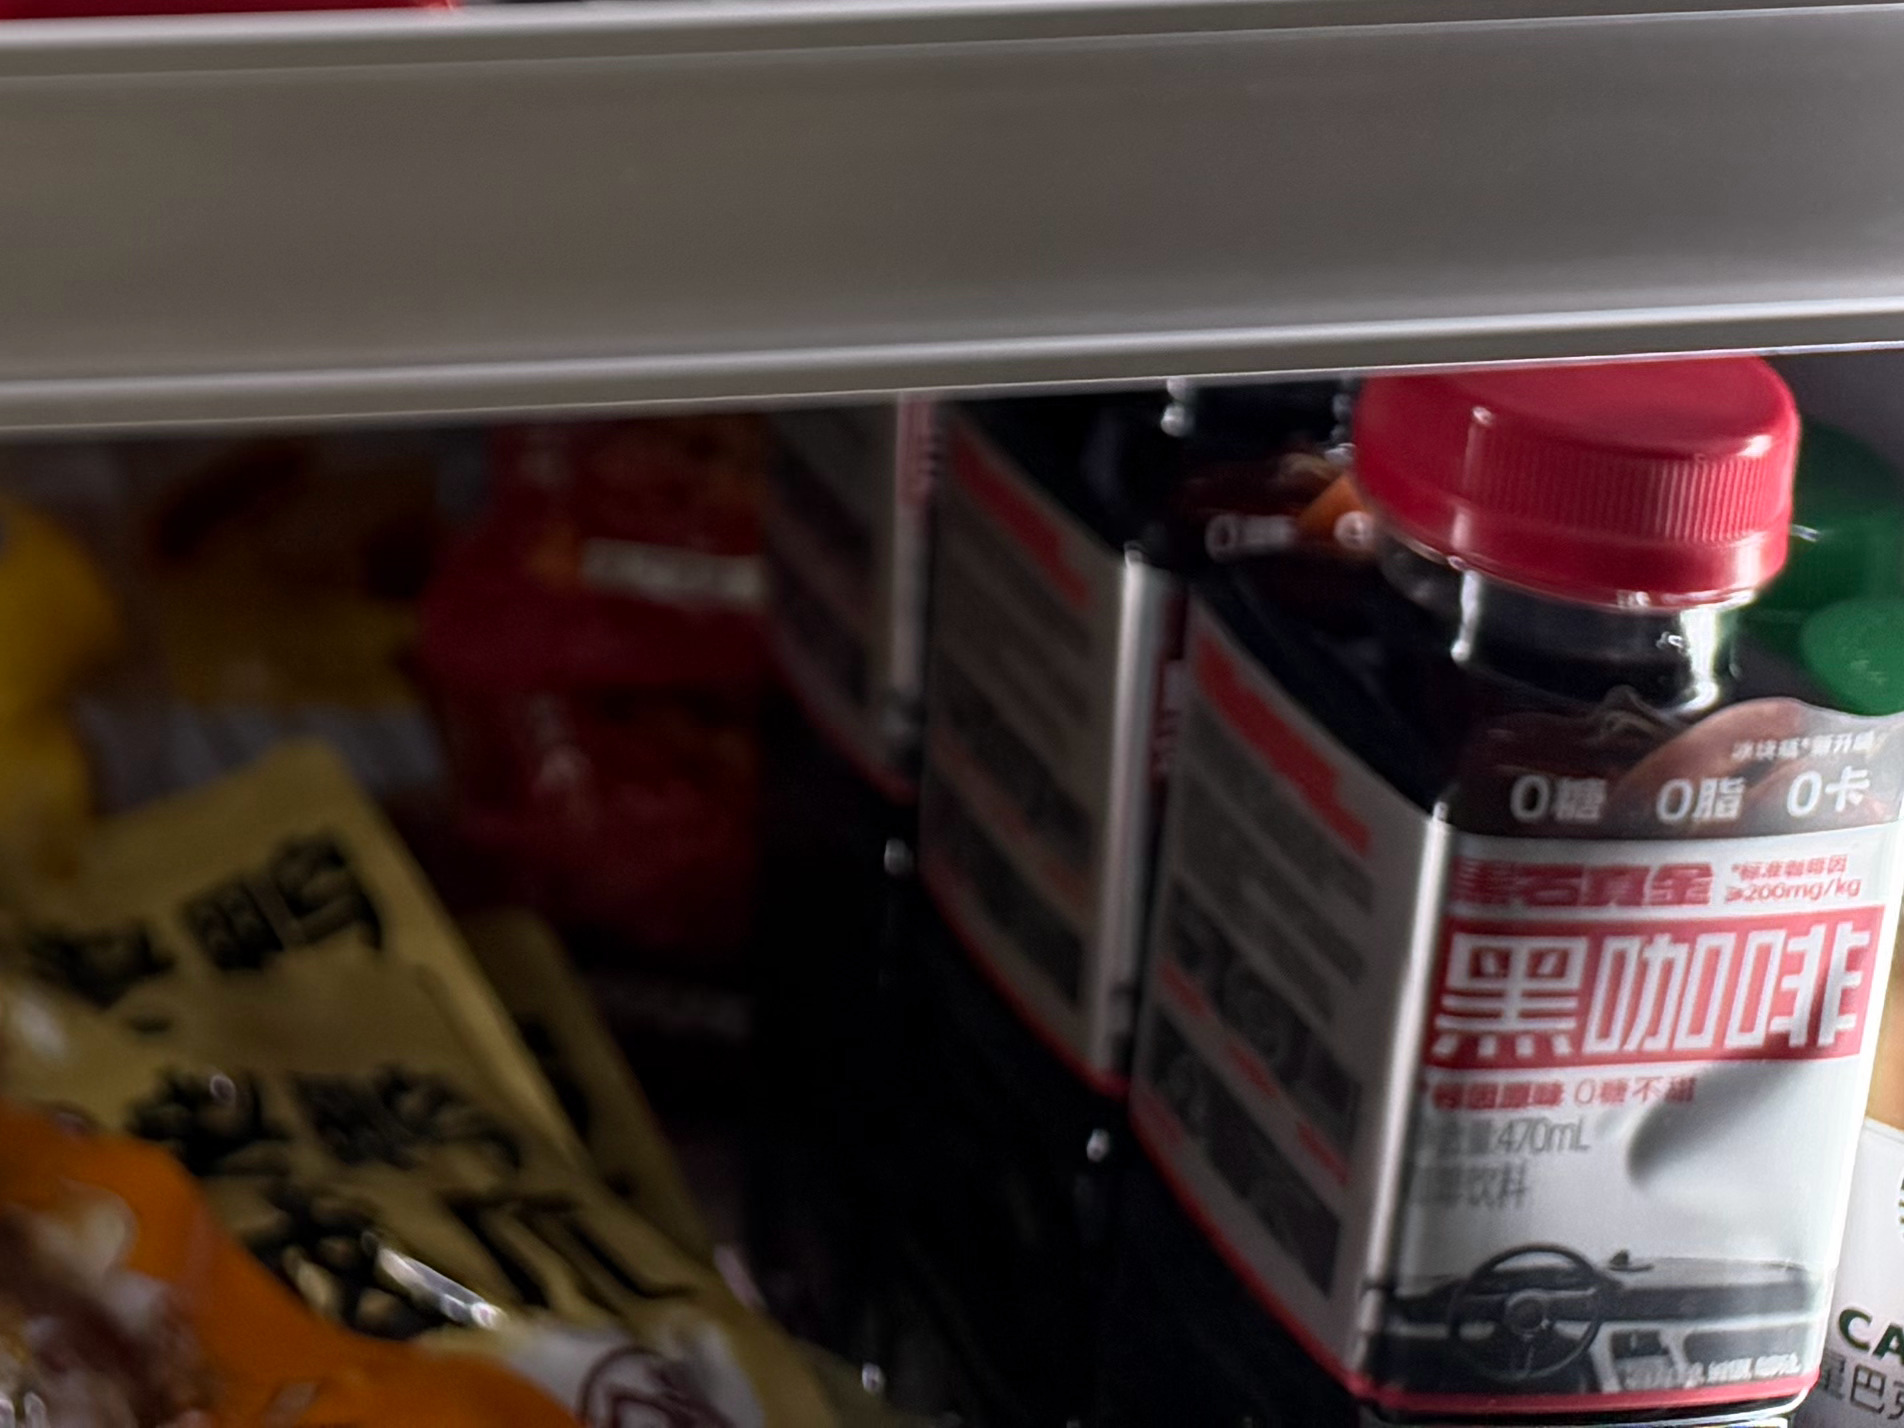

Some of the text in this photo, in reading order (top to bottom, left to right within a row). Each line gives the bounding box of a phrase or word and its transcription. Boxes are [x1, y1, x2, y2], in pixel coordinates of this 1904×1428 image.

[1655, 777, 1746, 823] 0脂
[1786, 765, 1871, 818] 0卡
[1430, 924, 1870, 1058] 黑咖啡
